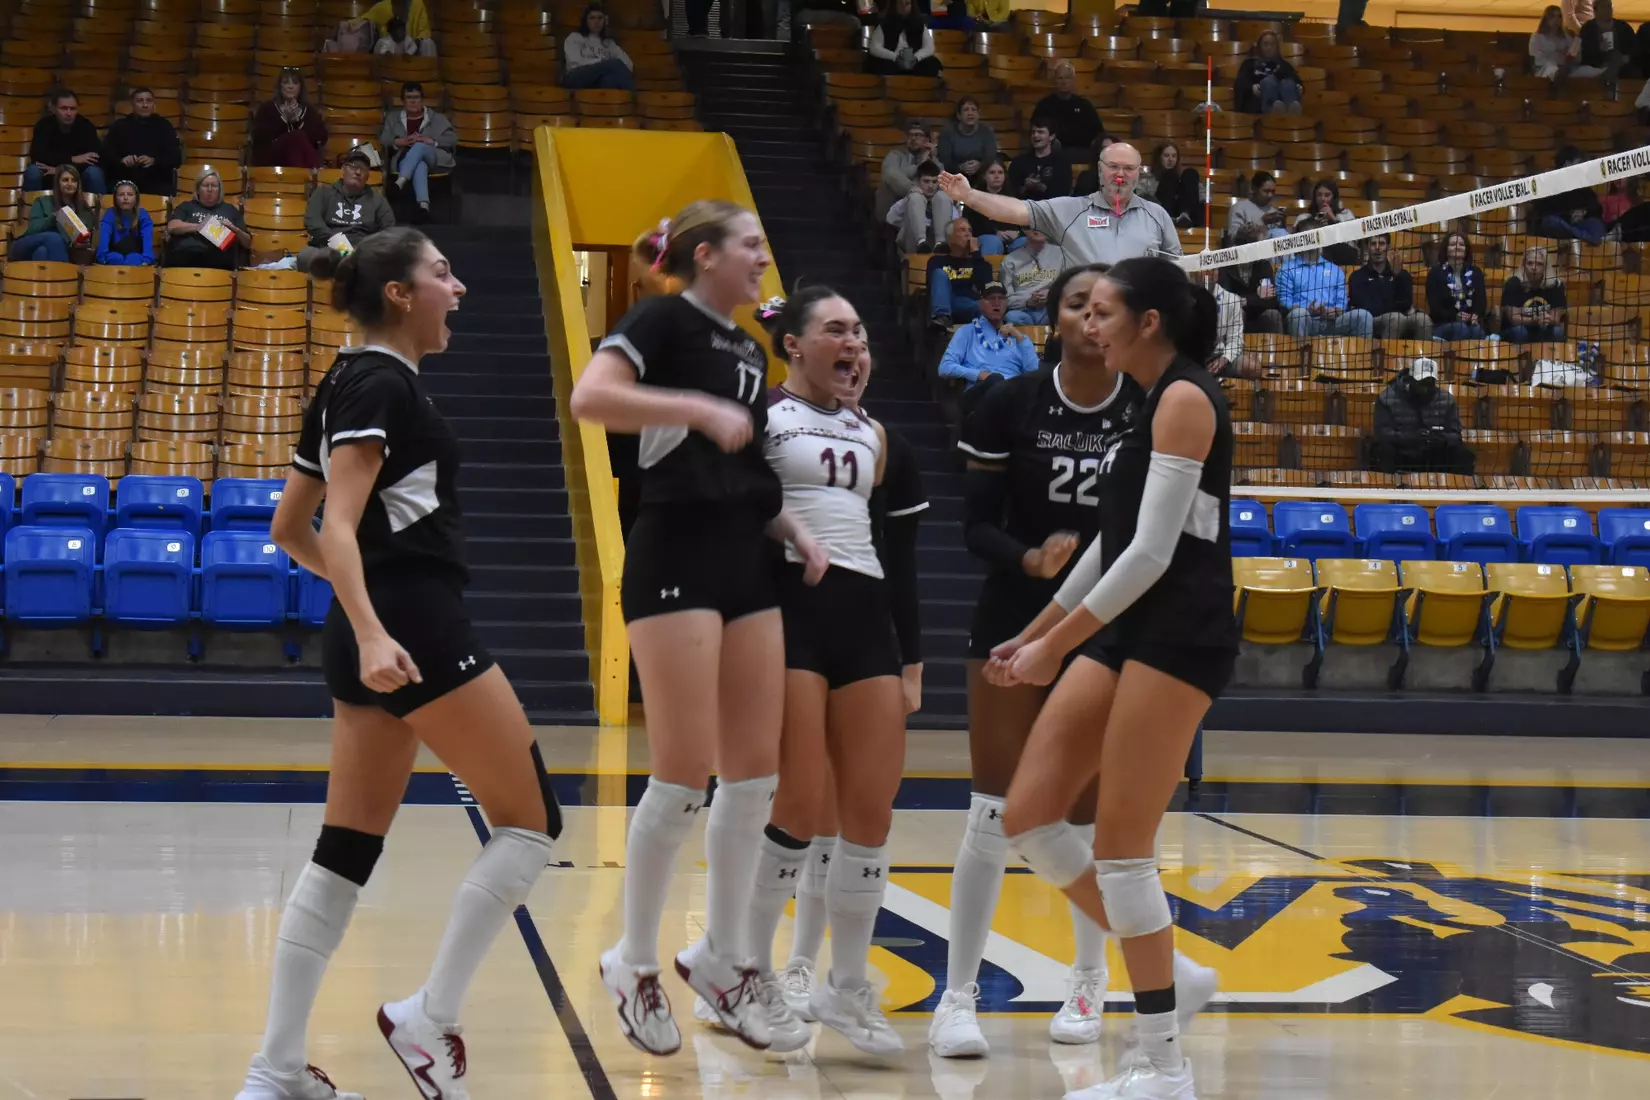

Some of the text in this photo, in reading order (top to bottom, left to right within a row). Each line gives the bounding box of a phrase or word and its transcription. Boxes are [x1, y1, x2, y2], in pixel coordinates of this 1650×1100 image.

[1607, 155, 1631, 175] RACER
[1366, 210, 1413, 231] RACER VOLLEYBALL
[735, 360, 763, 405] 17
[820, 447, 858, 490] 11
[1048, 455, 1100, 507] 22
